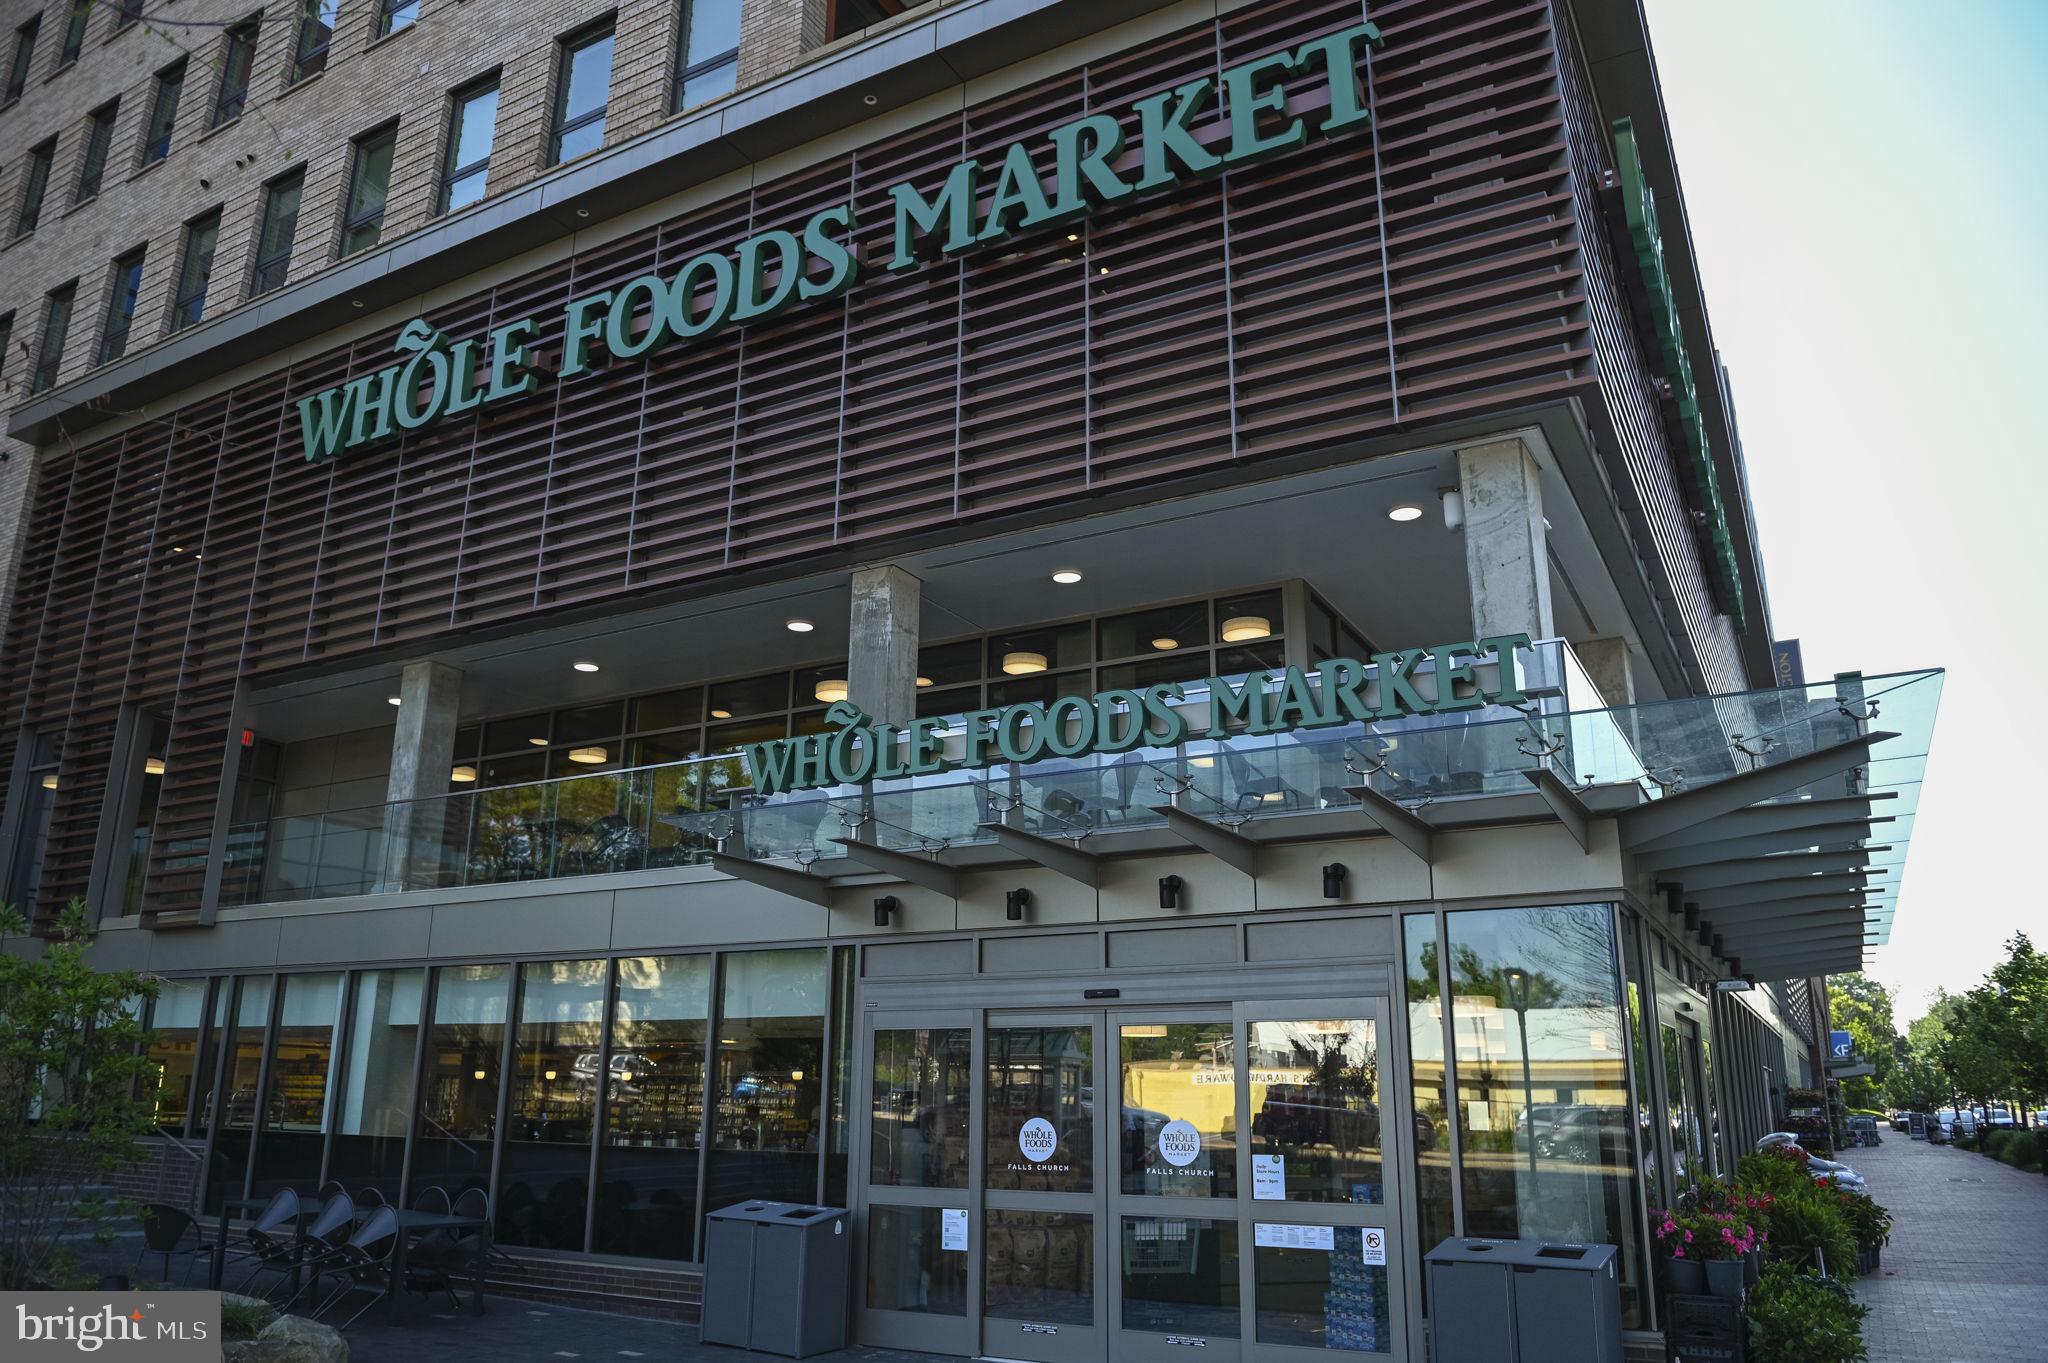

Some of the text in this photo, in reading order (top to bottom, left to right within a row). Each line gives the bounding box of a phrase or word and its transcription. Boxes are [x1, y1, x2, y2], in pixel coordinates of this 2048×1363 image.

[296, 22, 1385, 464] WHOLE FOODS MARKET
[744, 633, 1535, 796] WHOLE FOODS MARKET
[1023, 1126, 1053, 1140] WHOLE
[1163, 1129, 1196, 1143] WHOLE
[1025, 1139, 1053, 1148] FOODS
[1165, 1142, 1196, 1152] FOODS
[1007, 1163, 1069, 1172] FALLS CHURCH
[1178, 1169, 1214, 1177] CHURCH
